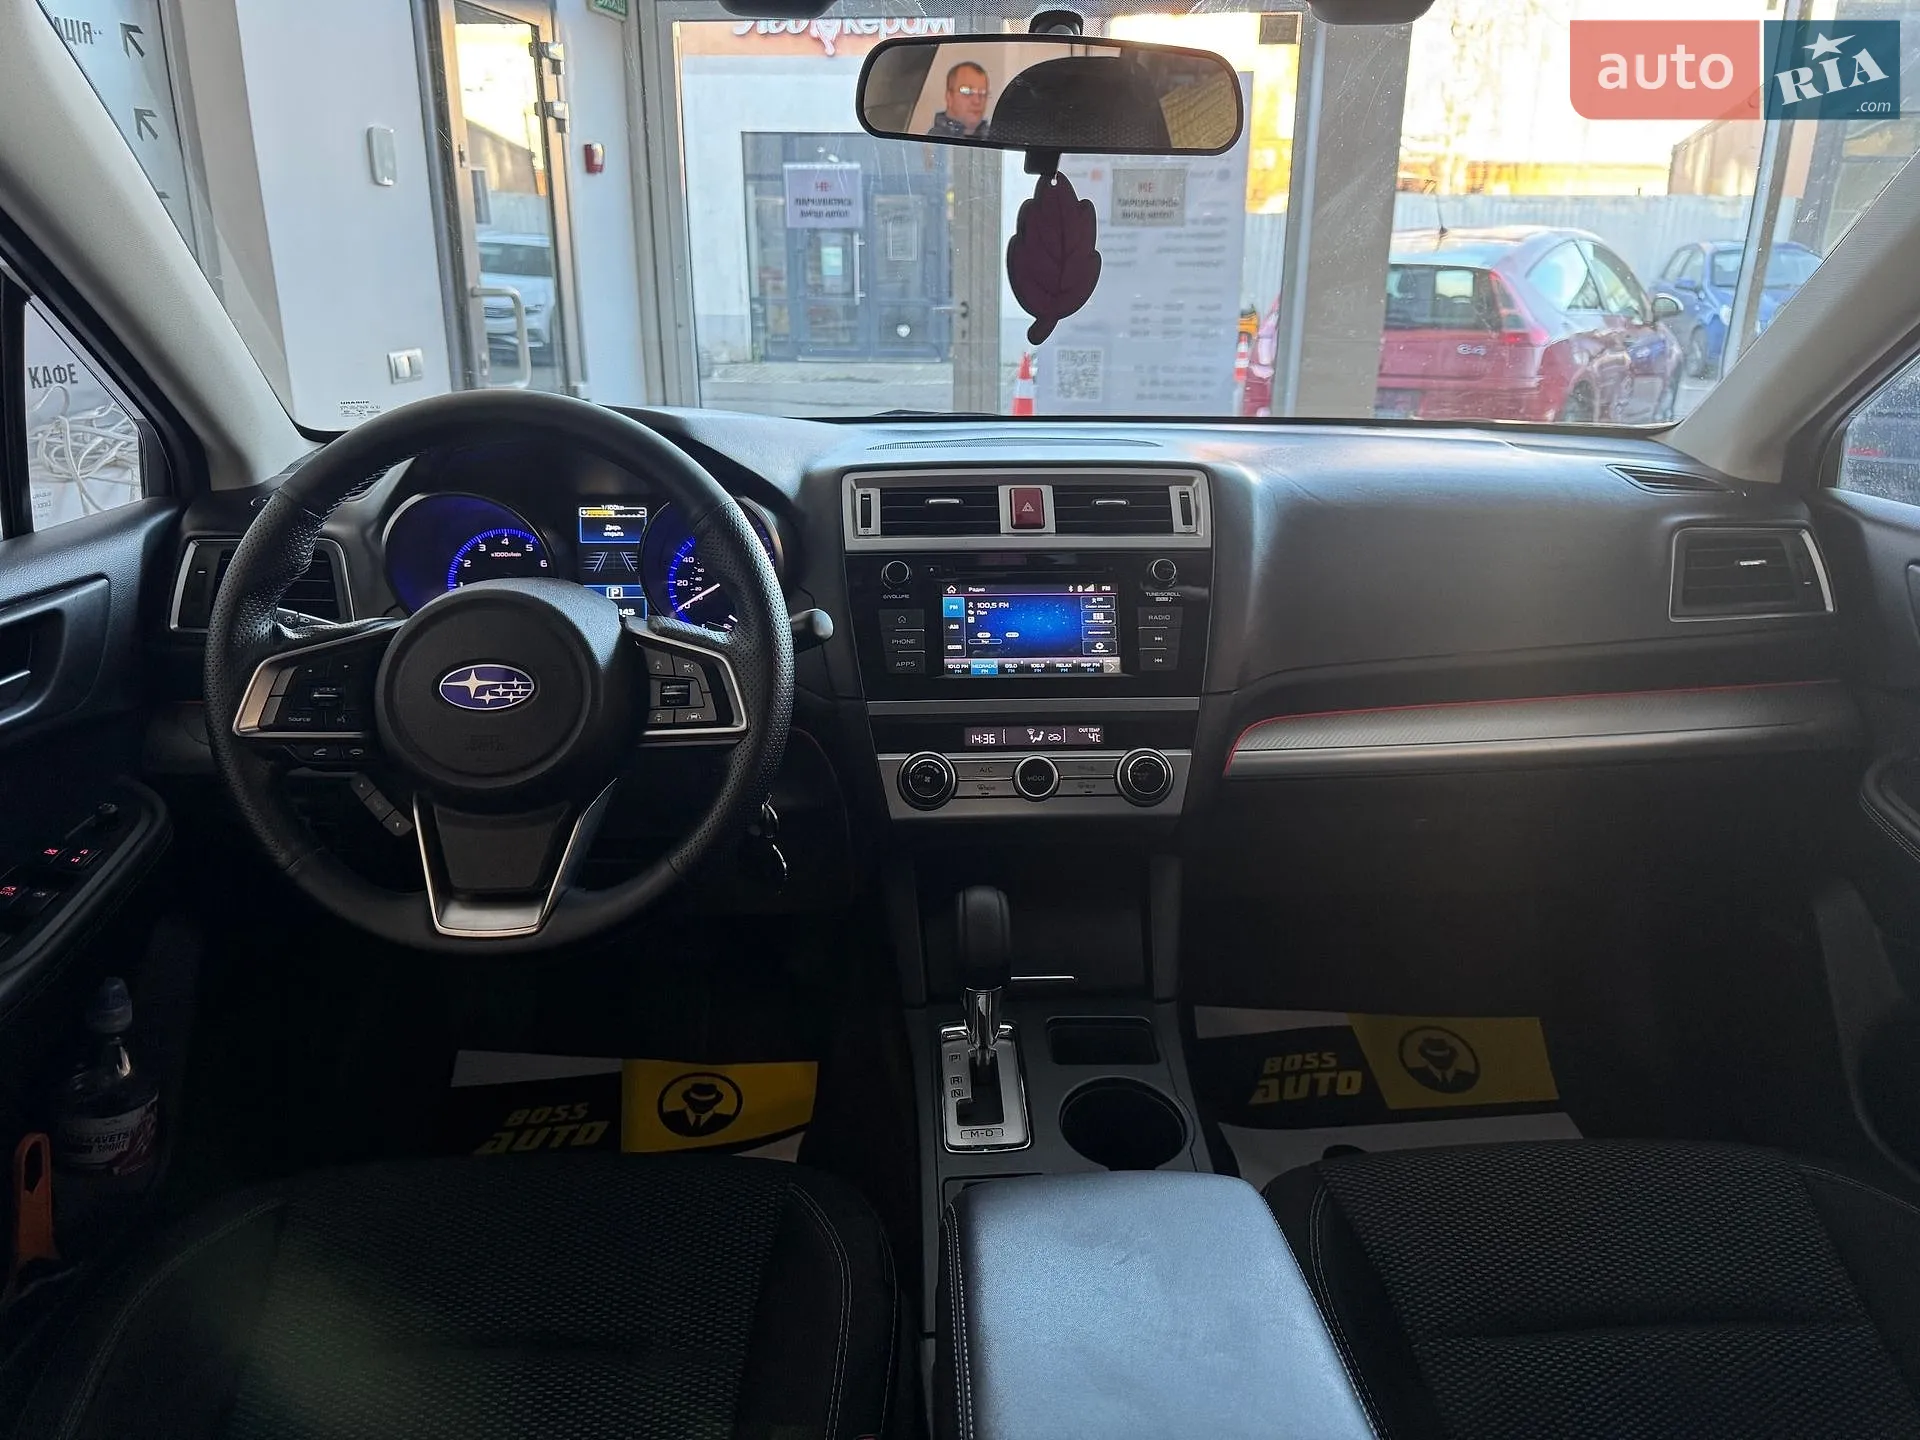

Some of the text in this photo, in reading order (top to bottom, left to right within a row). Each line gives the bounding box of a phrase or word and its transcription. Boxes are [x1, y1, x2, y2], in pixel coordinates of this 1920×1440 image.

[28, 363, 78, 389] КАФЕ
[525, 544, 533, 552] 5
[610, 588, 620, 597] P
[971, 733, 996, 744] 14:36
[1263, 1052, 1338, 1075] BOSS
[1248, 1070, 1362, 1106] AUTO
[502, 1101, 590, 1127] BOSS
[472, 1121, 611, 1155] AUTO
